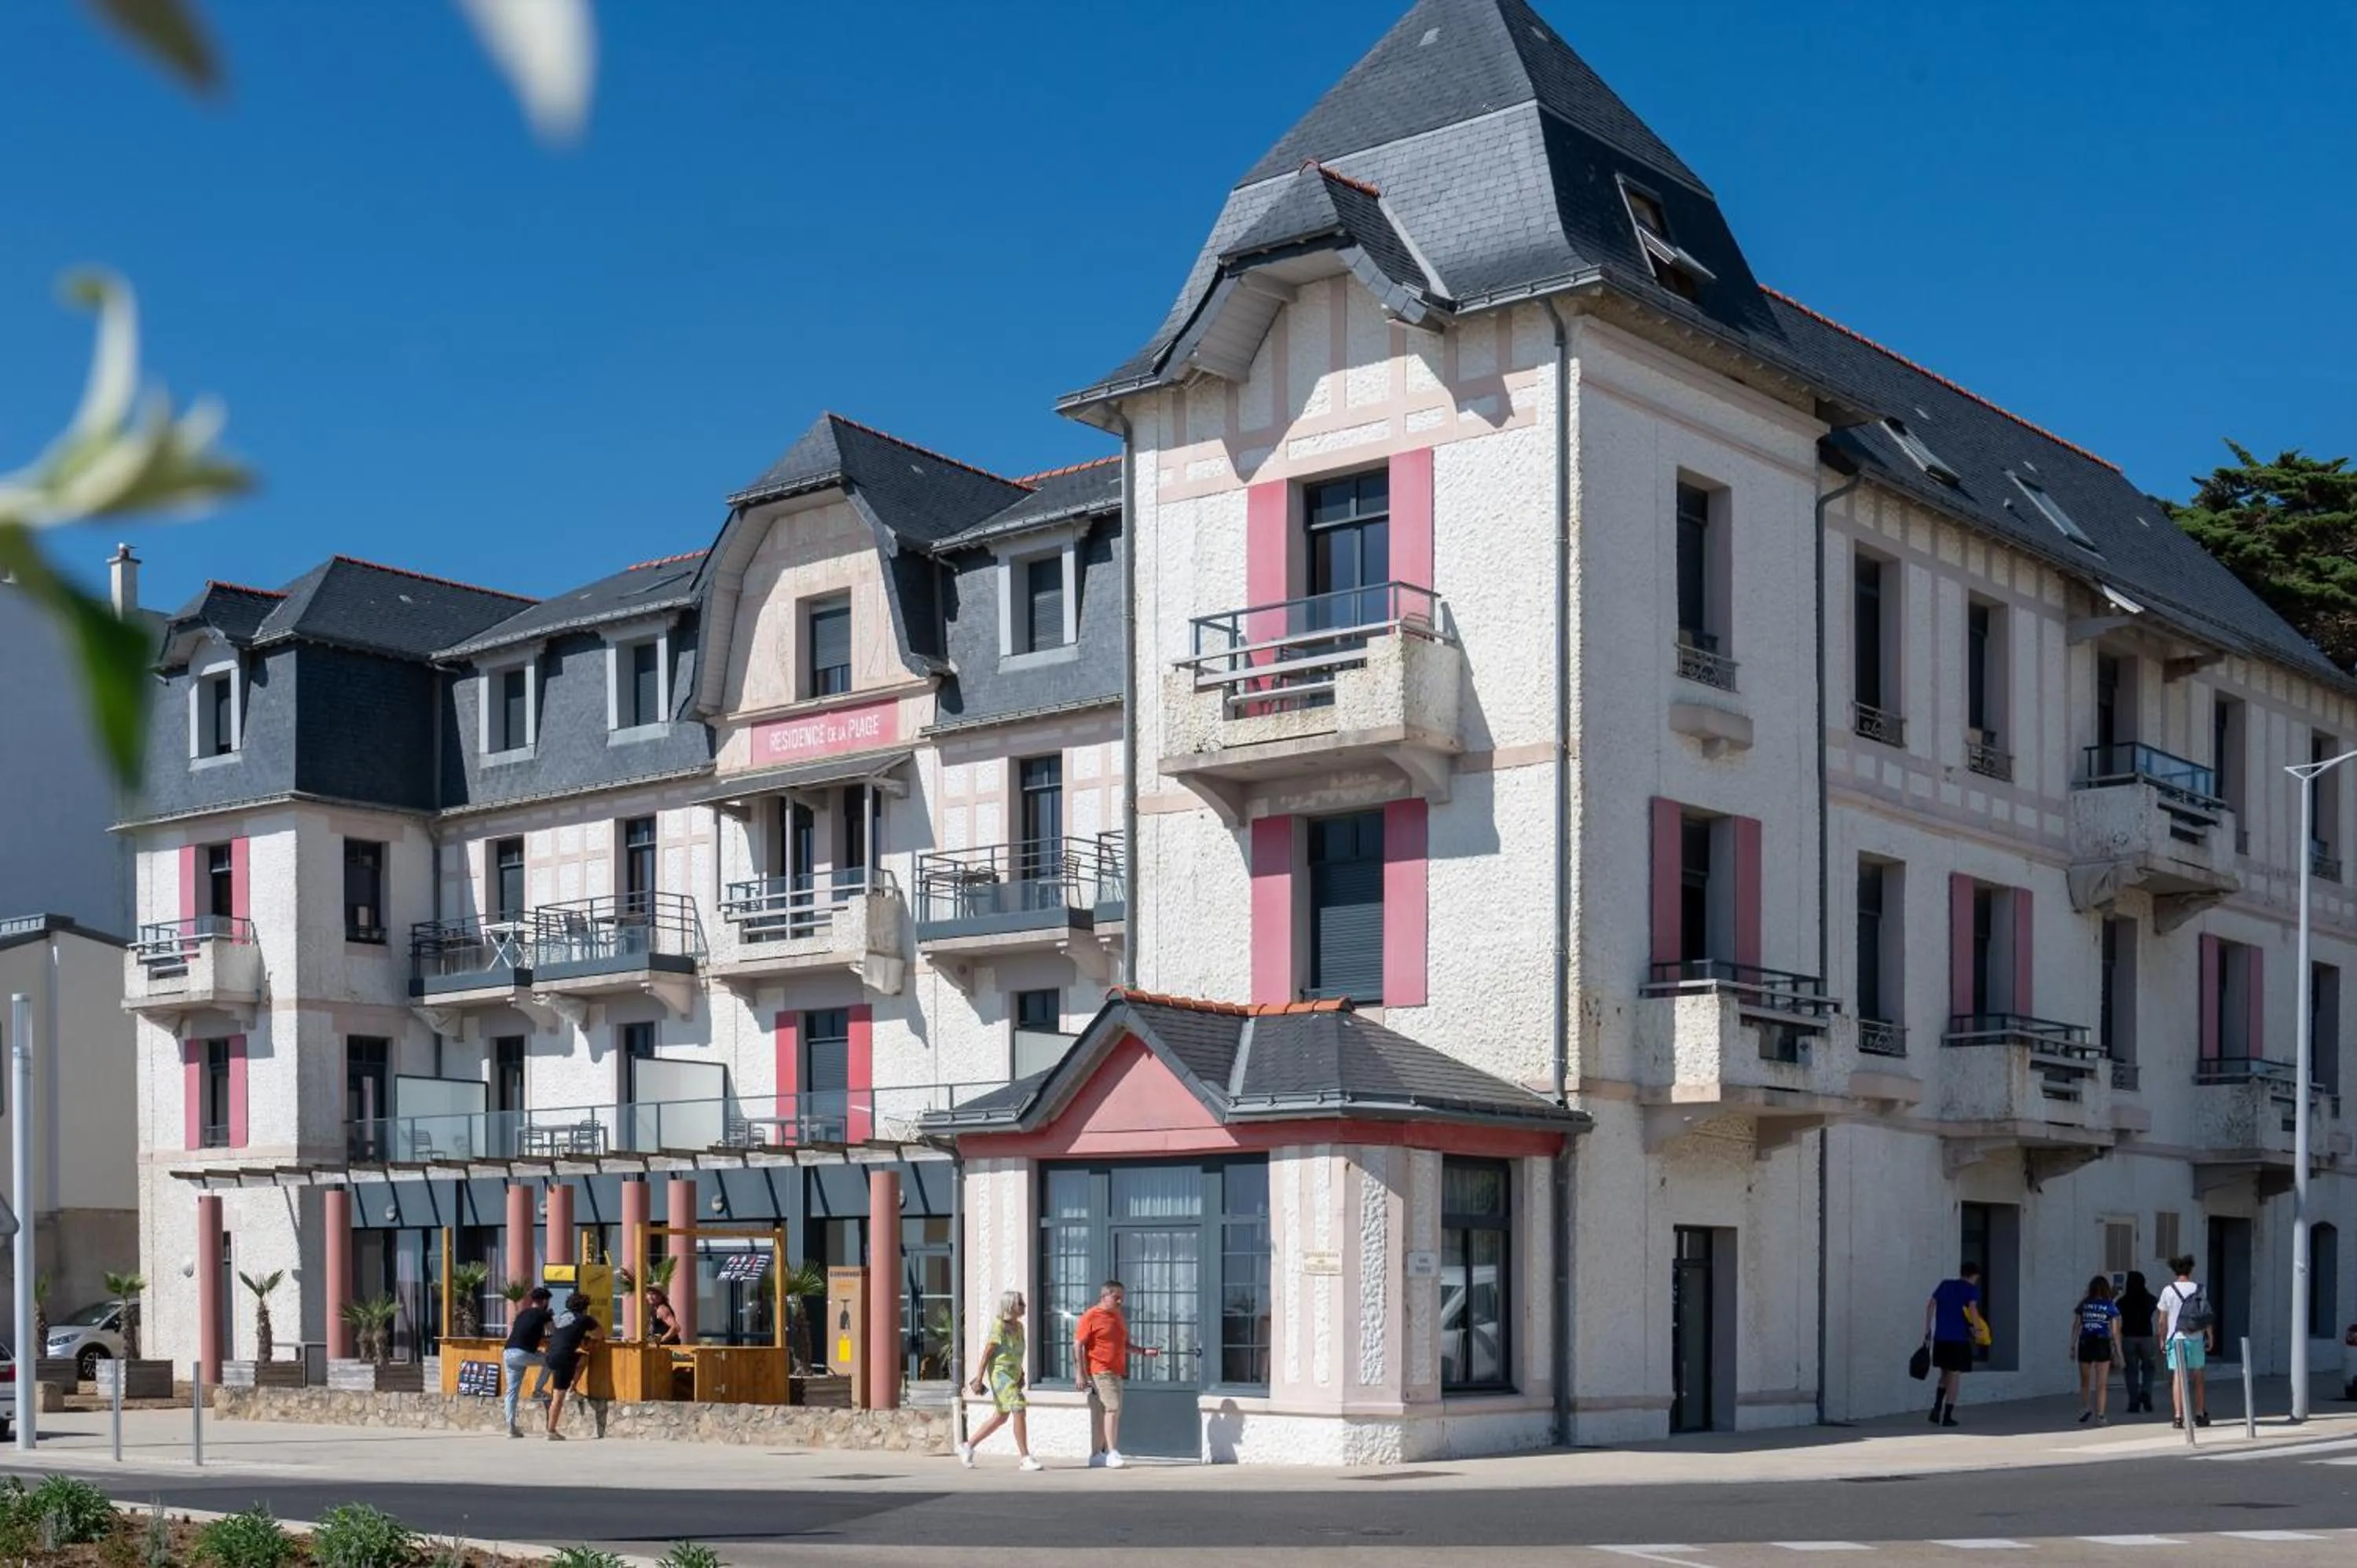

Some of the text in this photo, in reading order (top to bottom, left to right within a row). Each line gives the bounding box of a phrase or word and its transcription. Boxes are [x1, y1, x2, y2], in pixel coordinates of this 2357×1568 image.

[769, 714, 879, 752] RESIDENCE DE LA PLAGE
